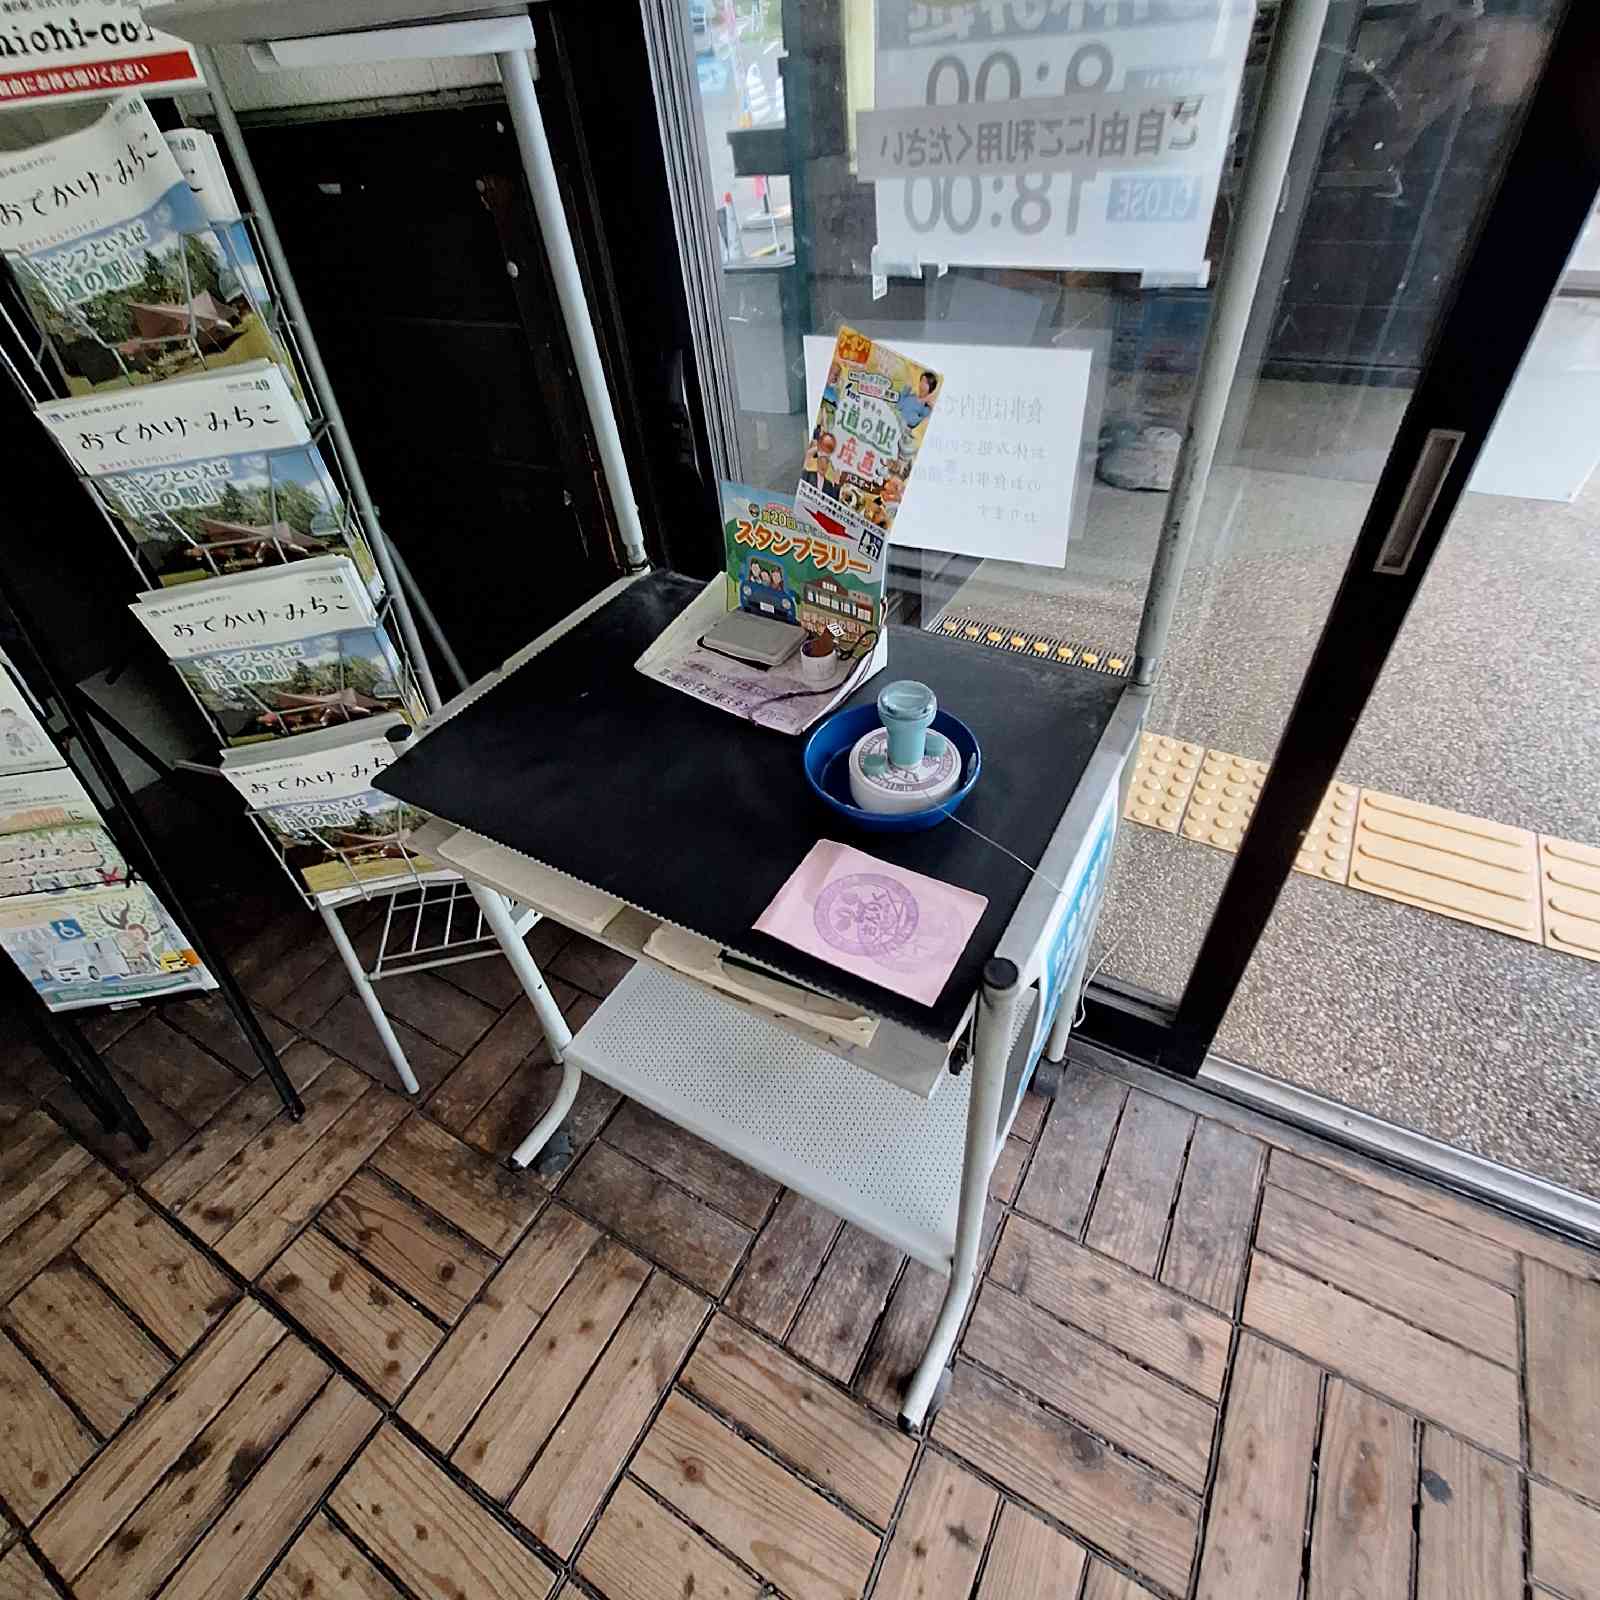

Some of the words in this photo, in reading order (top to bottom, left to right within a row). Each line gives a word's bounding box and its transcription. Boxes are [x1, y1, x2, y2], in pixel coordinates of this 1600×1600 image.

[838, 404, 898, 455] 道の駅
[735, 518, 872, 574] スタンプラリー
